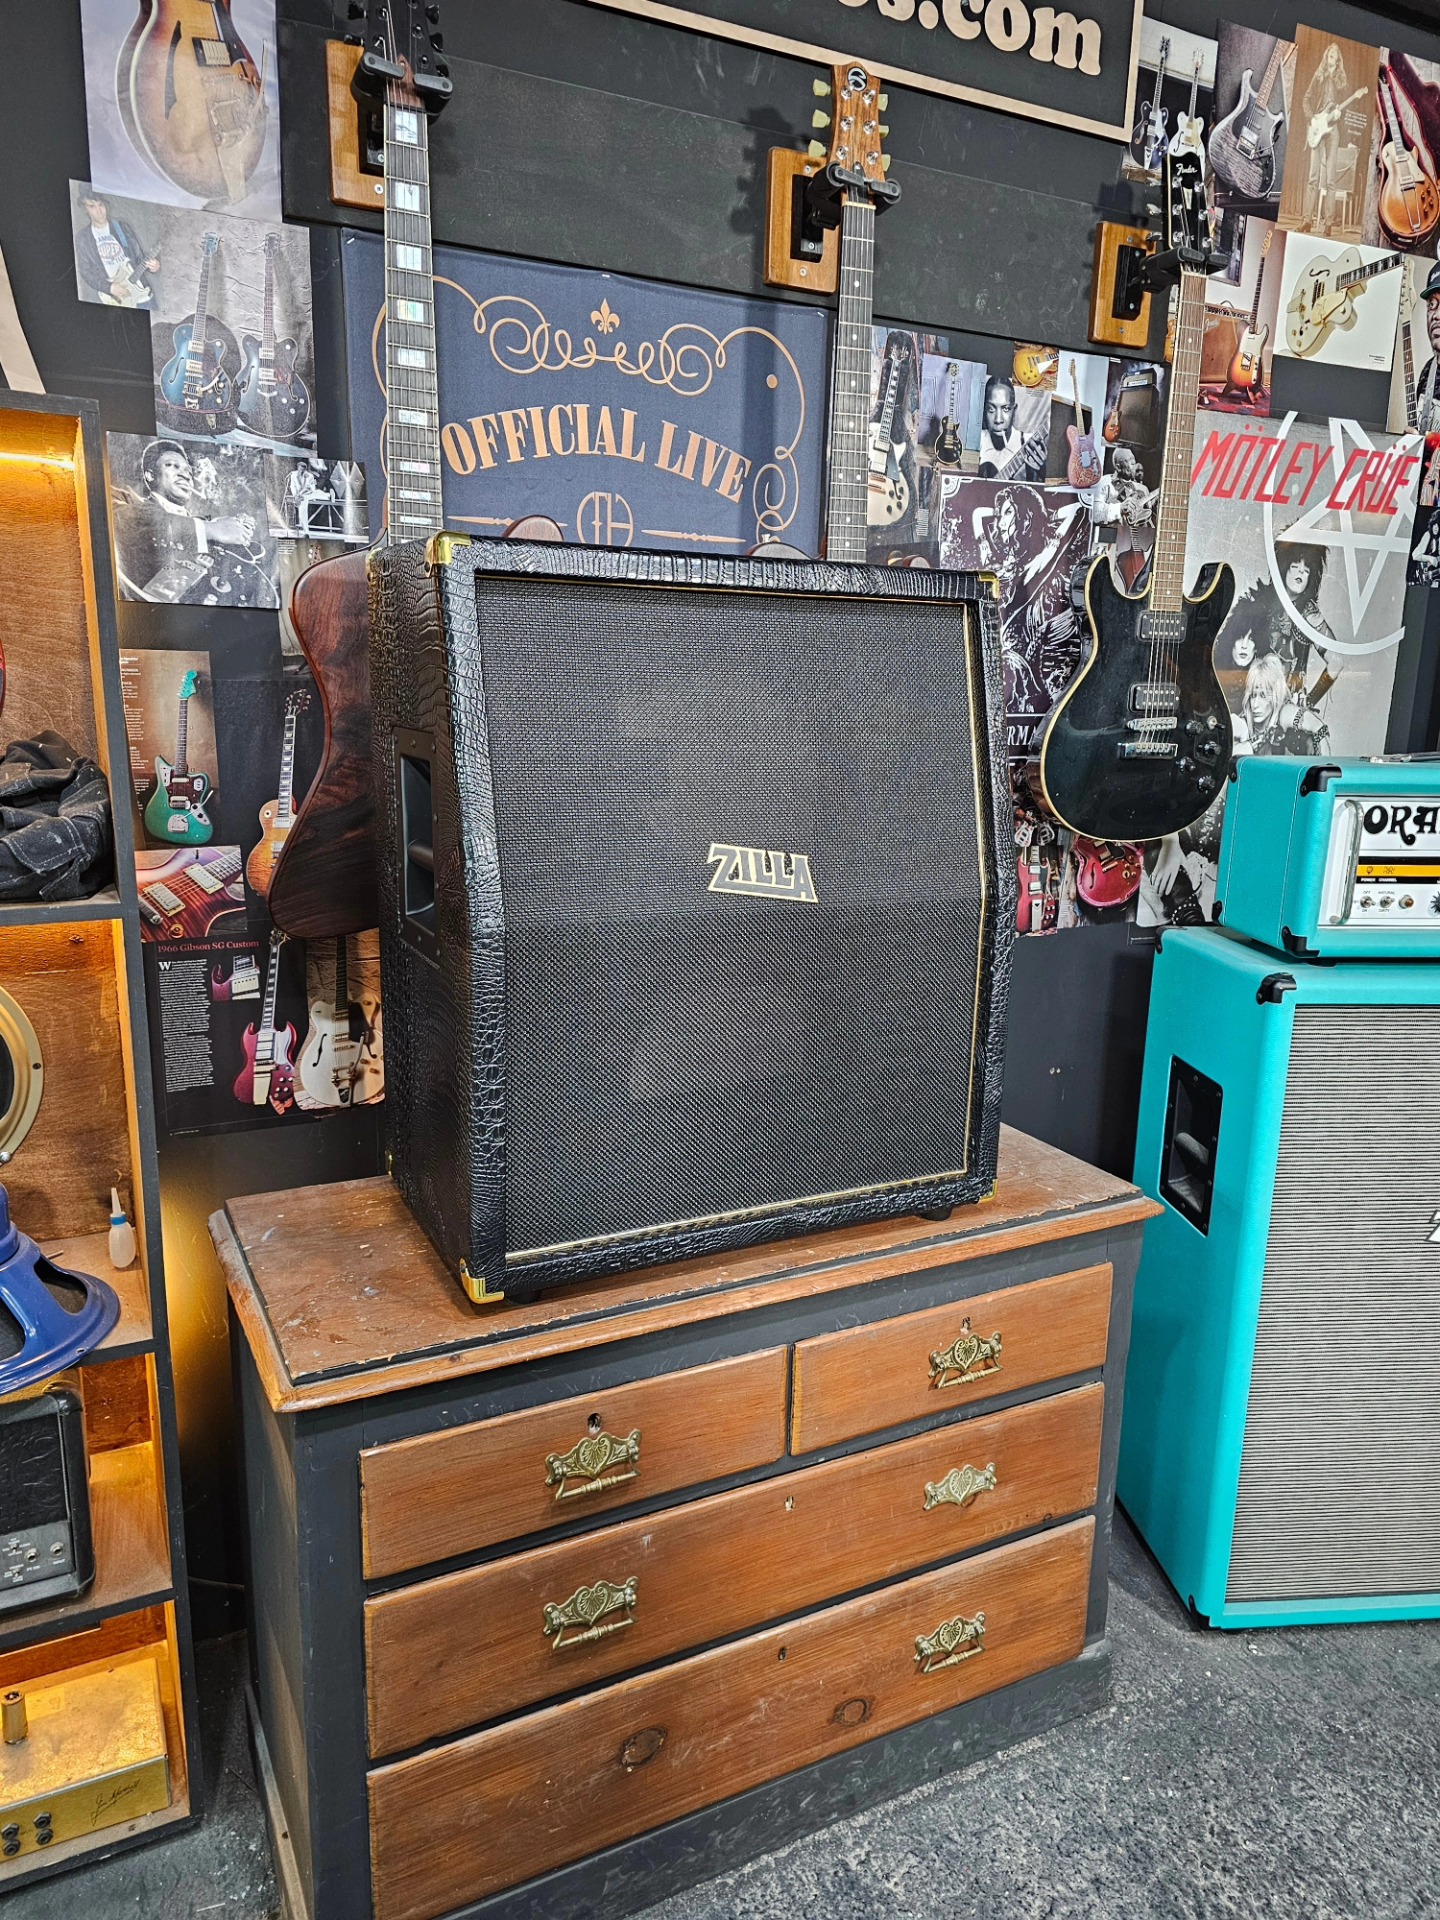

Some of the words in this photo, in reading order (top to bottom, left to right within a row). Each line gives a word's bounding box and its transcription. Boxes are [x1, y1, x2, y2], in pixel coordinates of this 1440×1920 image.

[1176, 163, 1198, 175] Fender
[441, 403, 646, 476] OFFICIAL
[654, 420, 752, 503] LIVE
[1190, 423, 1335, 507] MÖTLEY
[1325, 443, 1421, 516] CRÜE
[1363, 805, 1440, 846] ORA
[707, 843, 818, 903] ZILLA
[157, 945, 179, 953] 1966
[179, 943, 211, 952] Gibson
[211, 941, 225, 950] SG
[226, 941, 260, 949] Custom
